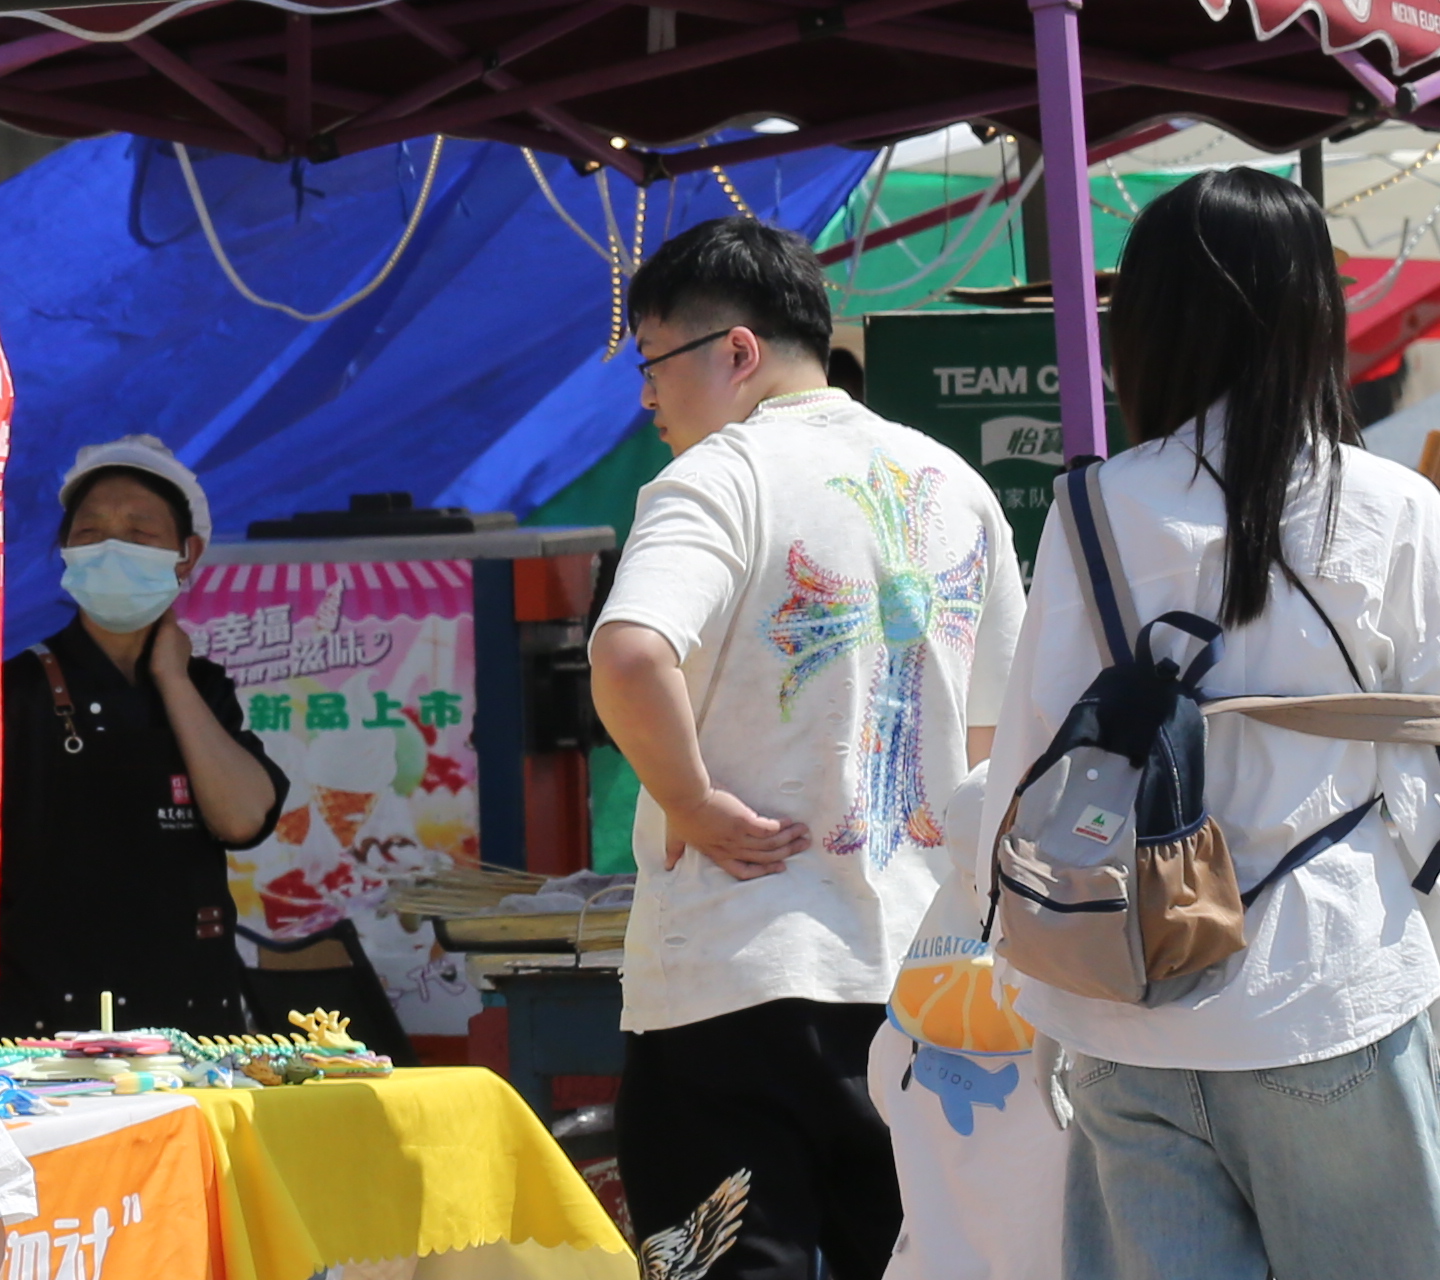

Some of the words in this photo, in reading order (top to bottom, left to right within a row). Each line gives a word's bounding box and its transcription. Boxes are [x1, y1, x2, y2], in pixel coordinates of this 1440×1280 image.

[933, 366, 1028, 396] TEAM
[995, 487, 1049, 510] 家队
[248, 690, 463, 732] 新品上市
